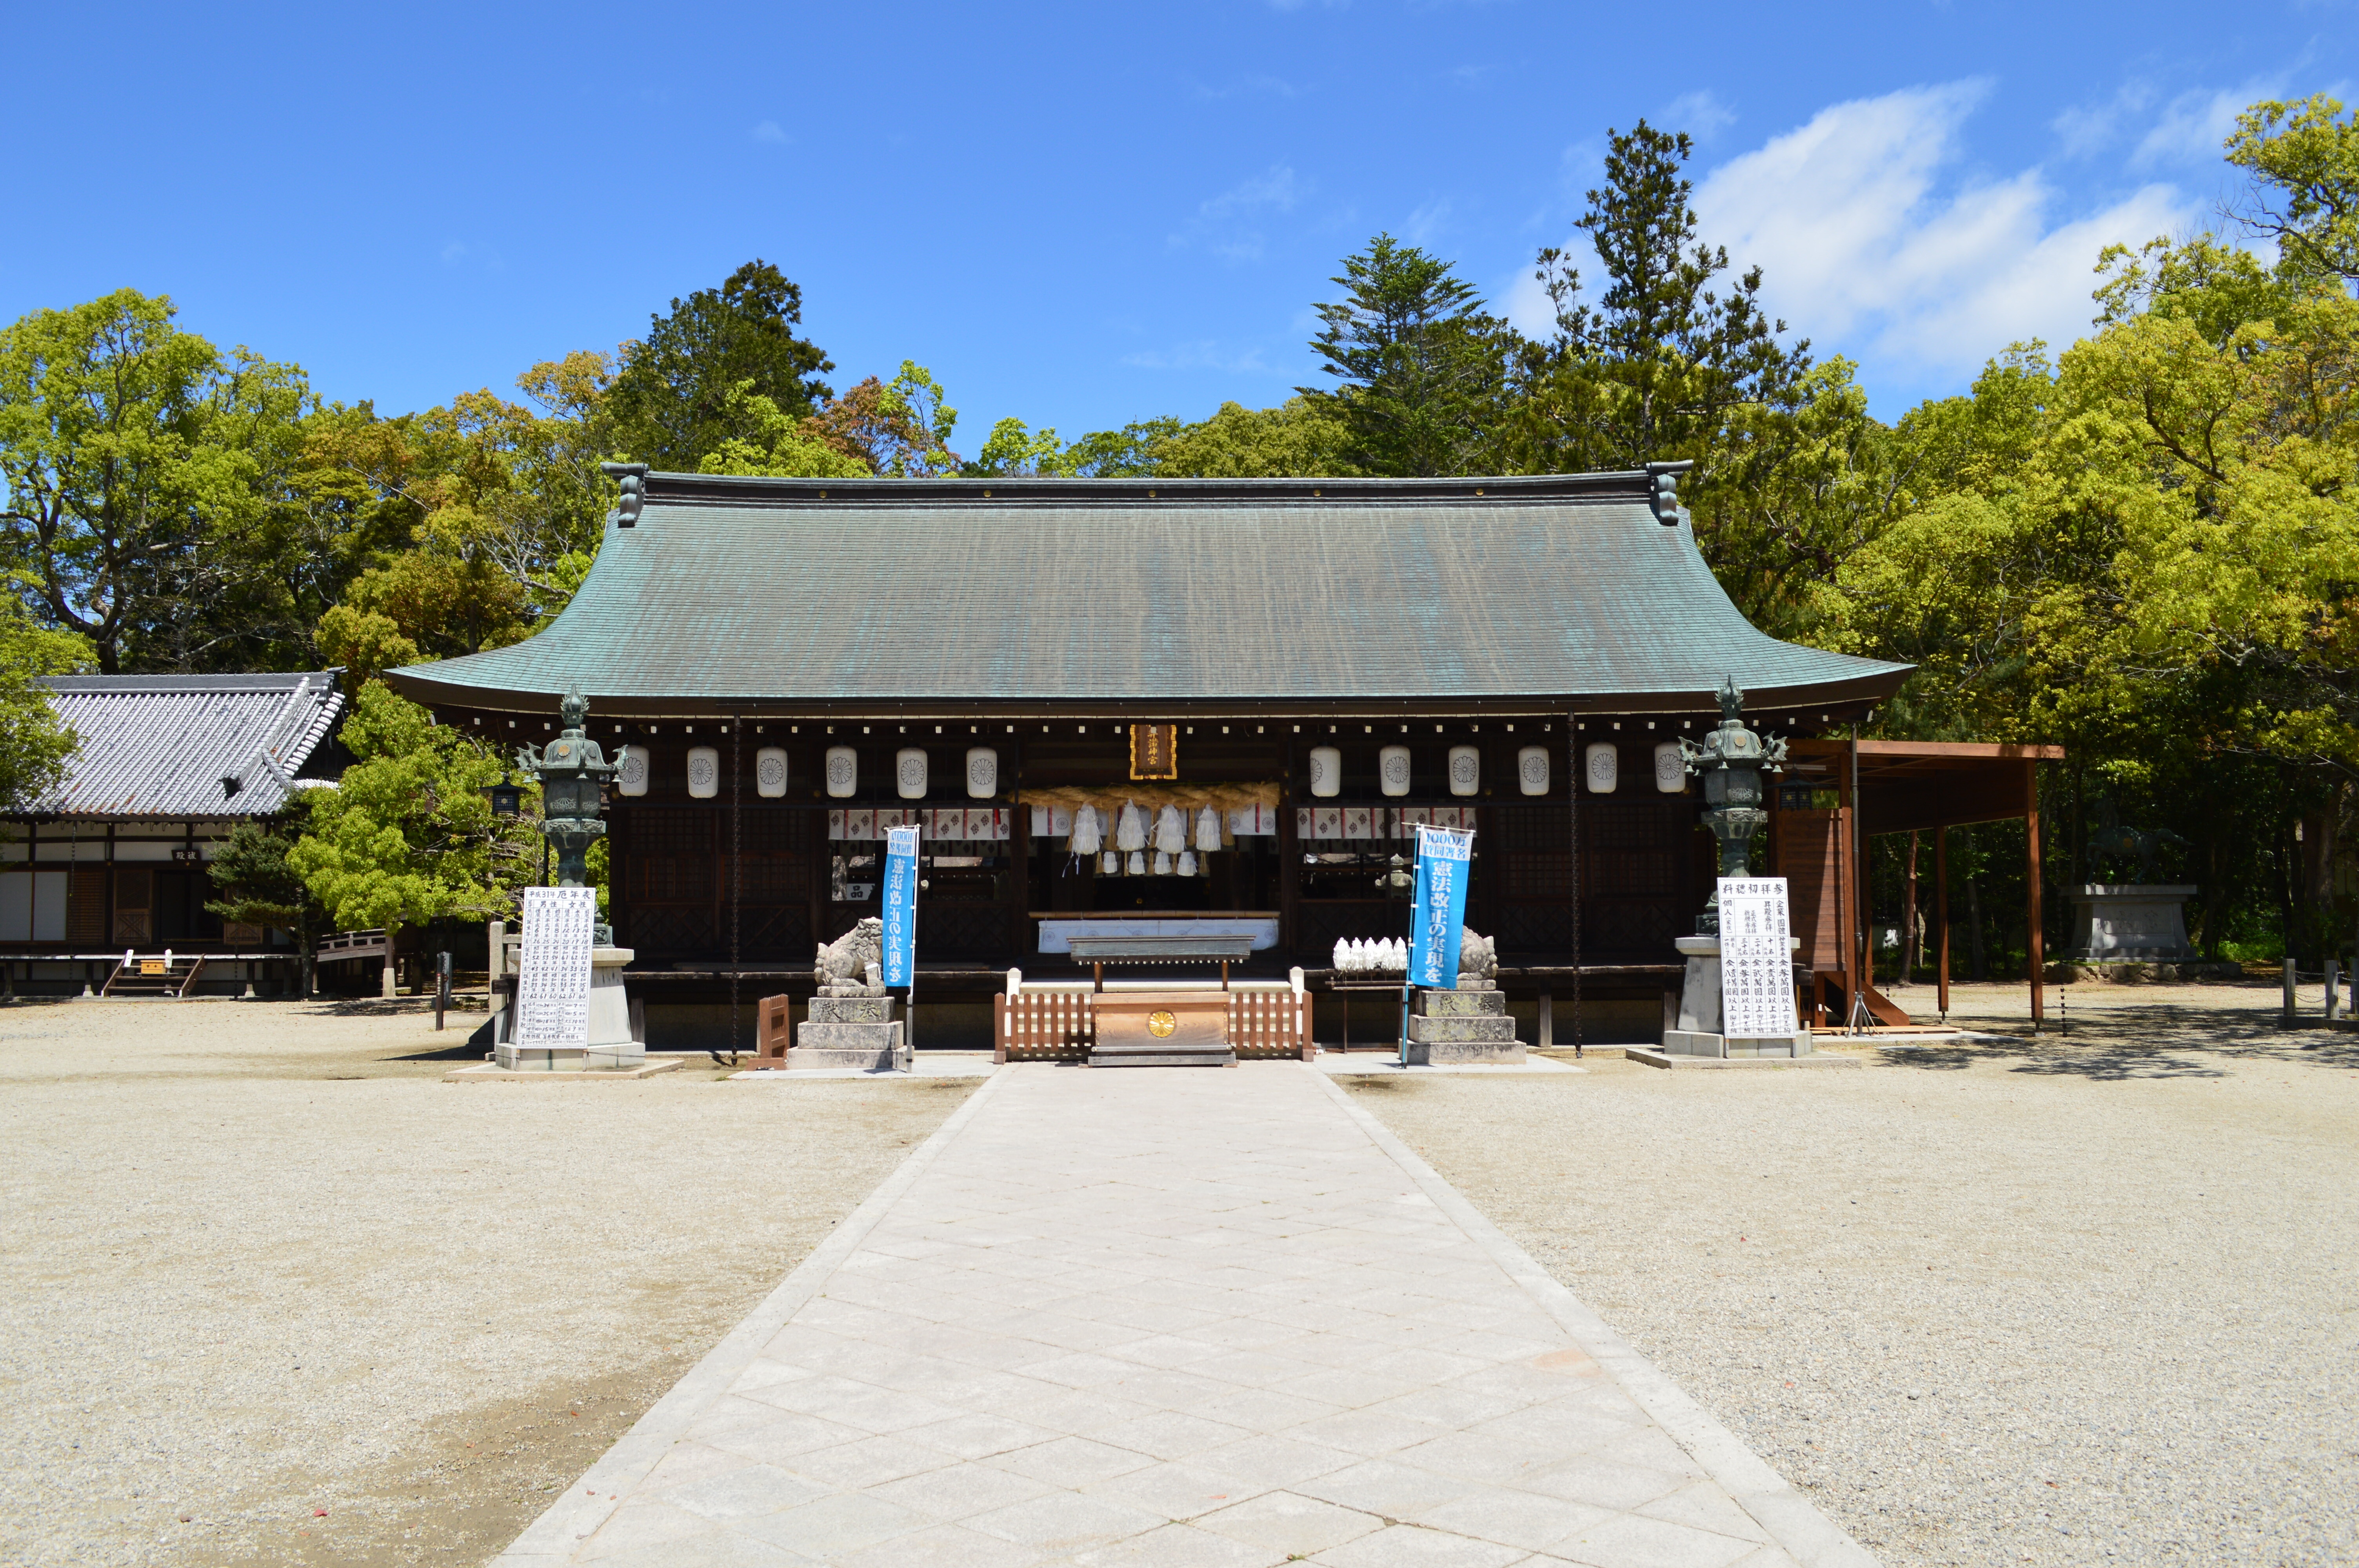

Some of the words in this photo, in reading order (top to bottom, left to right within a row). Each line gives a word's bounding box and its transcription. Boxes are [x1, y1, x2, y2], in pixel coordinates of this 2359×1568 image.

[1426, 833, 1466, 846] 1000万
[1424, 844, 1466, 858] 賛同署名
[1425, 860, 1453, 983] 憲法改正の実現を
